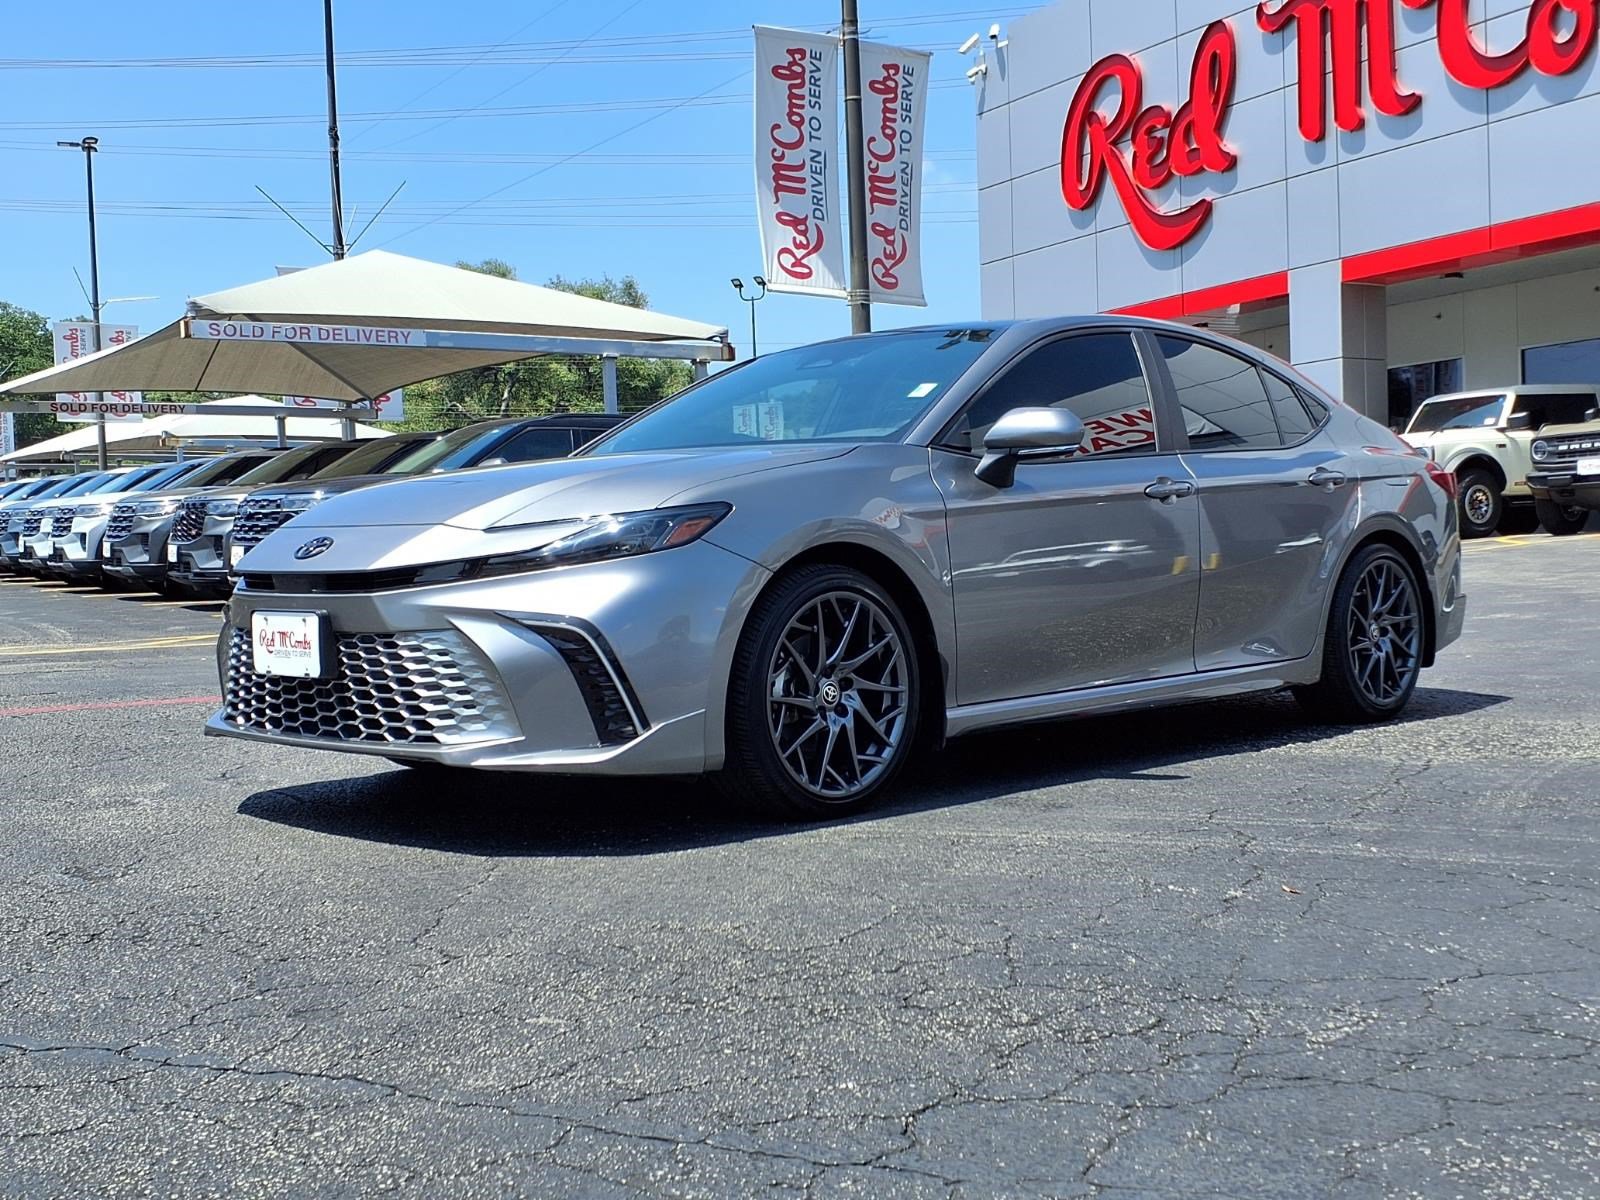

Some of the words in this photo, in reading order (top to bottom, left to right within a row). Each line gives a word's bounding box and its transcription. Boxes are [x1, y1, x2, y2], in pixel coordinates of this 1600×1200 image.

[808, 48, 822, 111] SERVE
[900, 64, 915, 124] SERVE
[771, 47, 807, 205] McCombs
[808, 115, 822, 143] TO
[867, 63, 900, 215] McCombs
[899, 129, 913, 155] TO
[1061, 19, 1236, 250] Red
[810, 149, 825, 222] DRIVEN
[899, 161, 910, 233] DRIVEN
[776, 211, 825, 280] Red
[870, 221, 908, 290] Red
[208, 322, 265, 340] SOLD
[271, 325, 312, 341] FOR
[318, 327, 412, 345] DELIVERY
[50, 402, 88, 413] SOLD
[91, 402, 118, 413] FOR
[122, 403, 186, 414] DELIVERY
[259, 628, 275, 654] Red
[277, 630, 312, 650] McCombs
[274, 649, 291, 657] DRIVEN
[299, 650, 312, 658] SERVE
